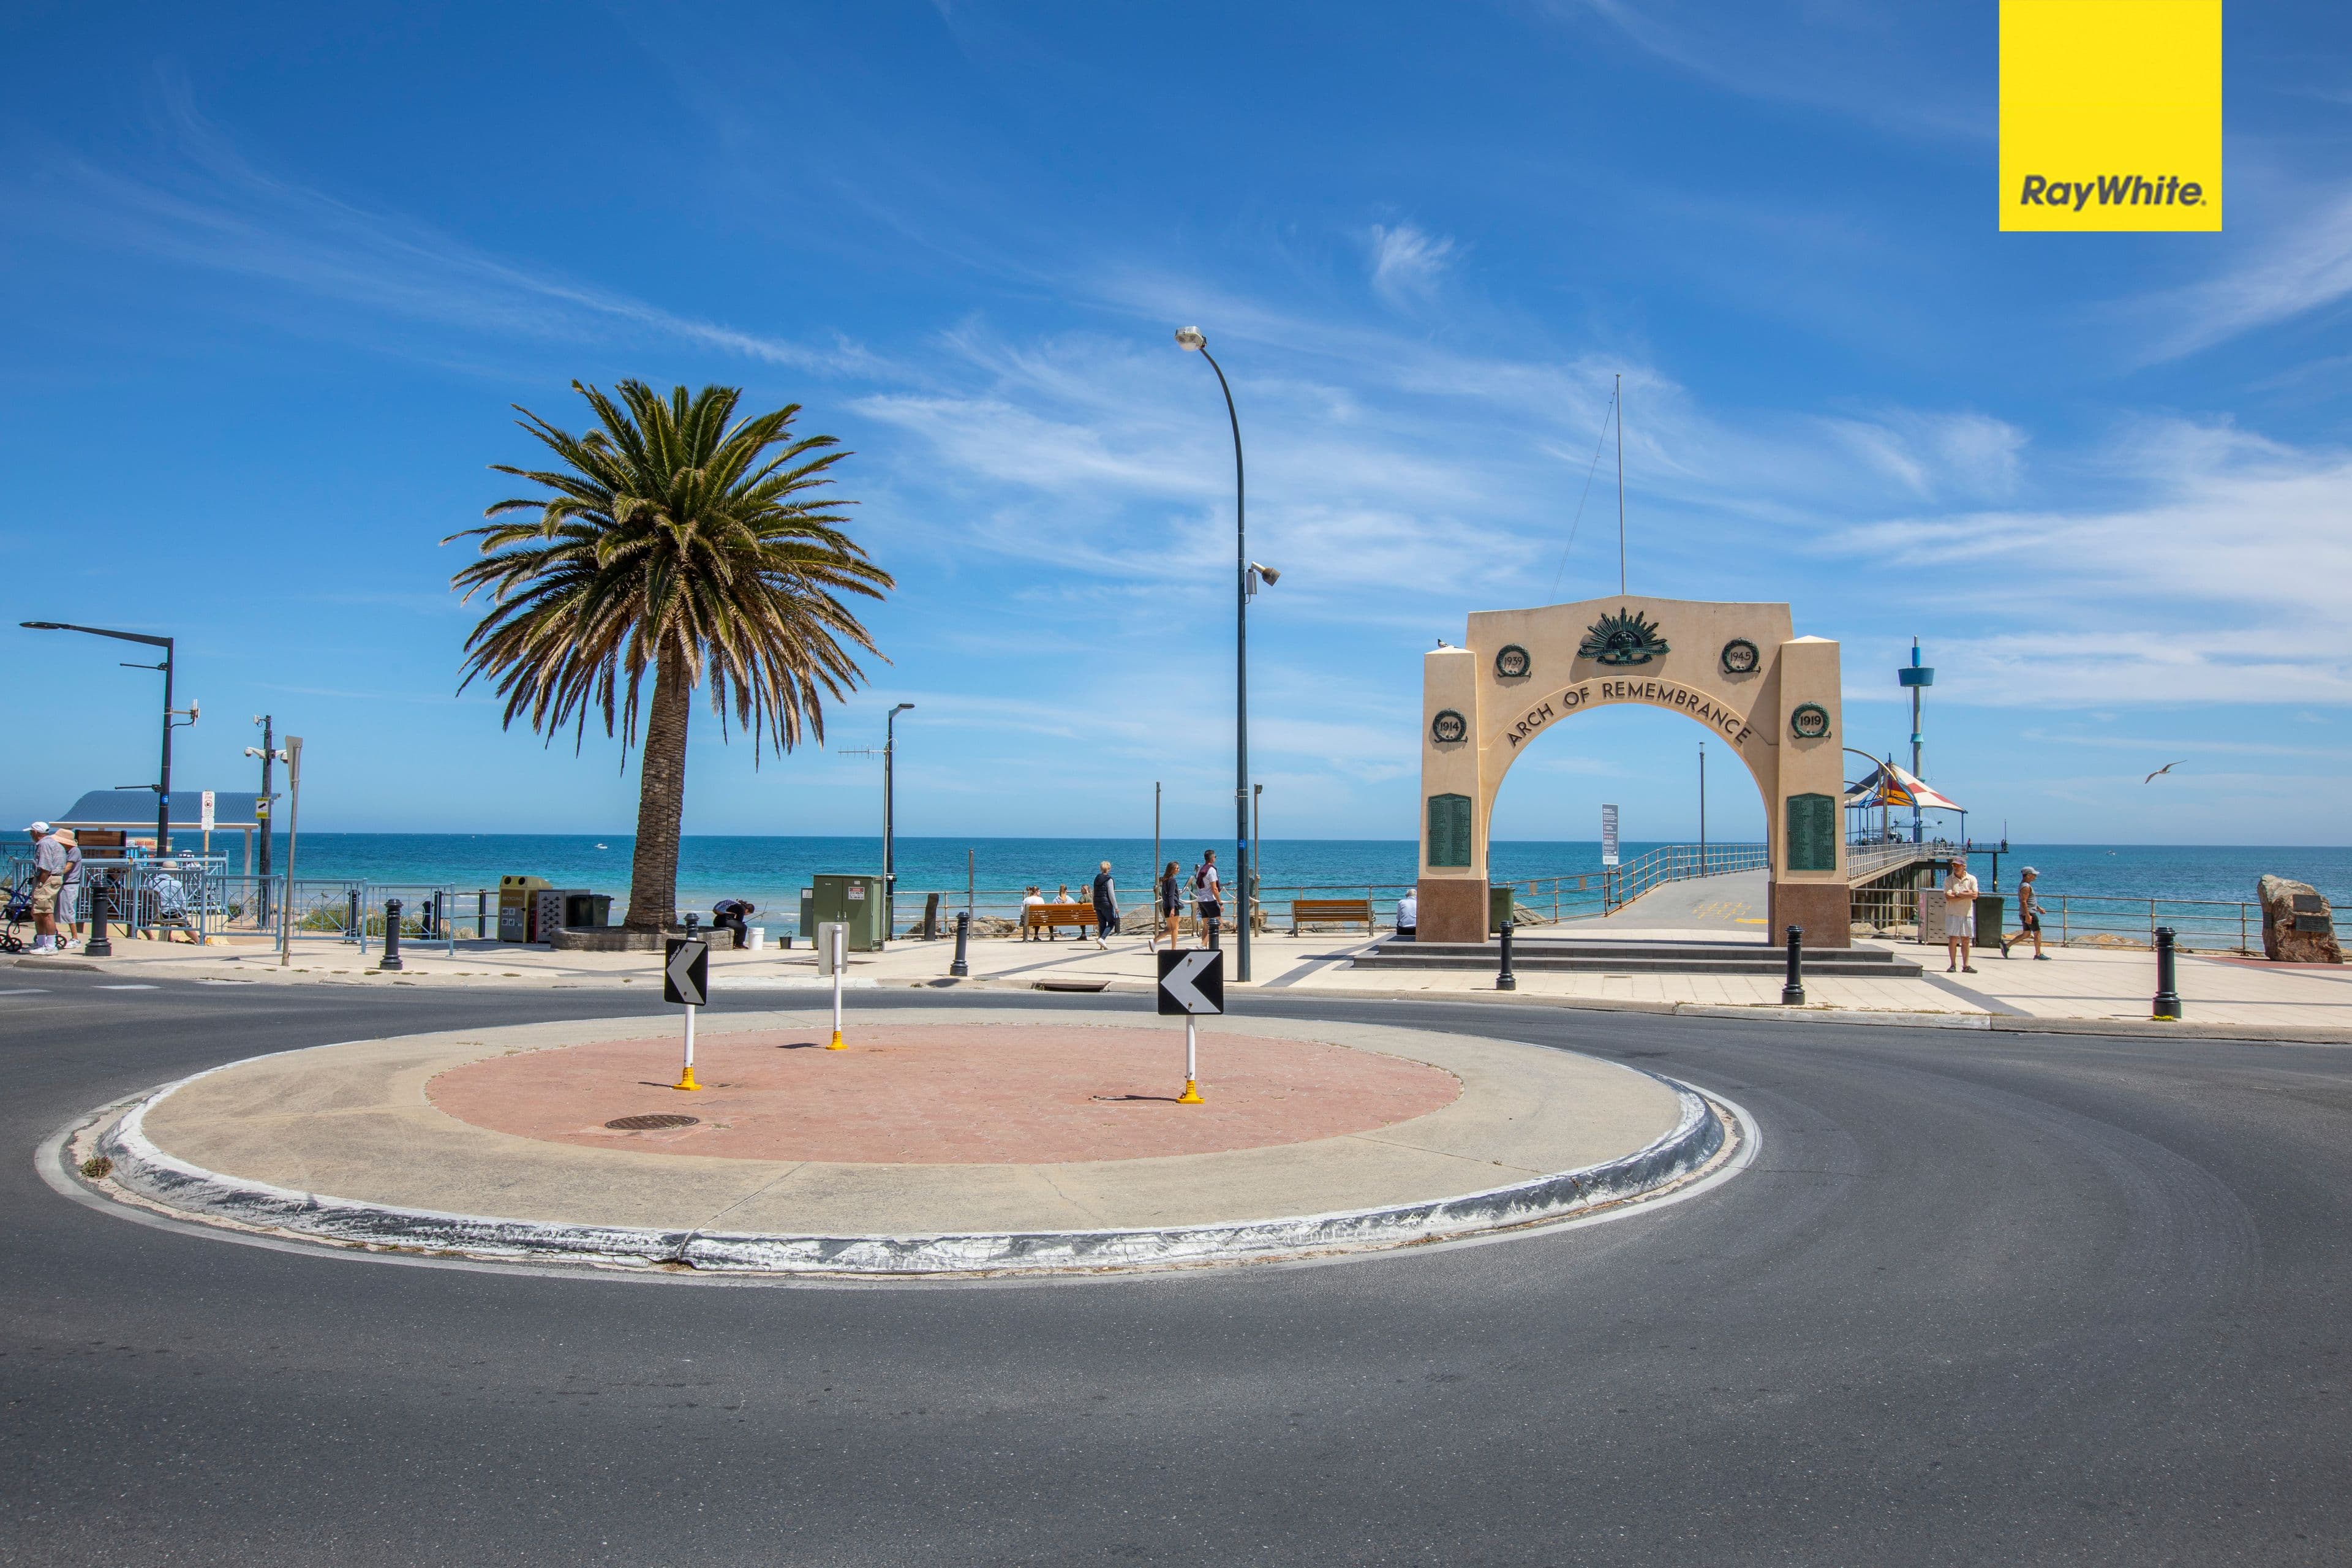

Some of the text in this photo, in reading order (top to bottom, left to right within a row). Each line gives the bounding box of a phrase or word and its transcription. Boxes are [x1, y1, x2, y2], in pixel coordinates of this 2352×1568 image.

[1504, 657, 1523, 666] 1939
[1730, 652, 1751, 662] 1945
[1507, 681, 1752, 747] ARCH OF REMEMBRANCE
[1800, 715, 1822, 726] 1919
[1440, 721, 1460, 731] 1914
